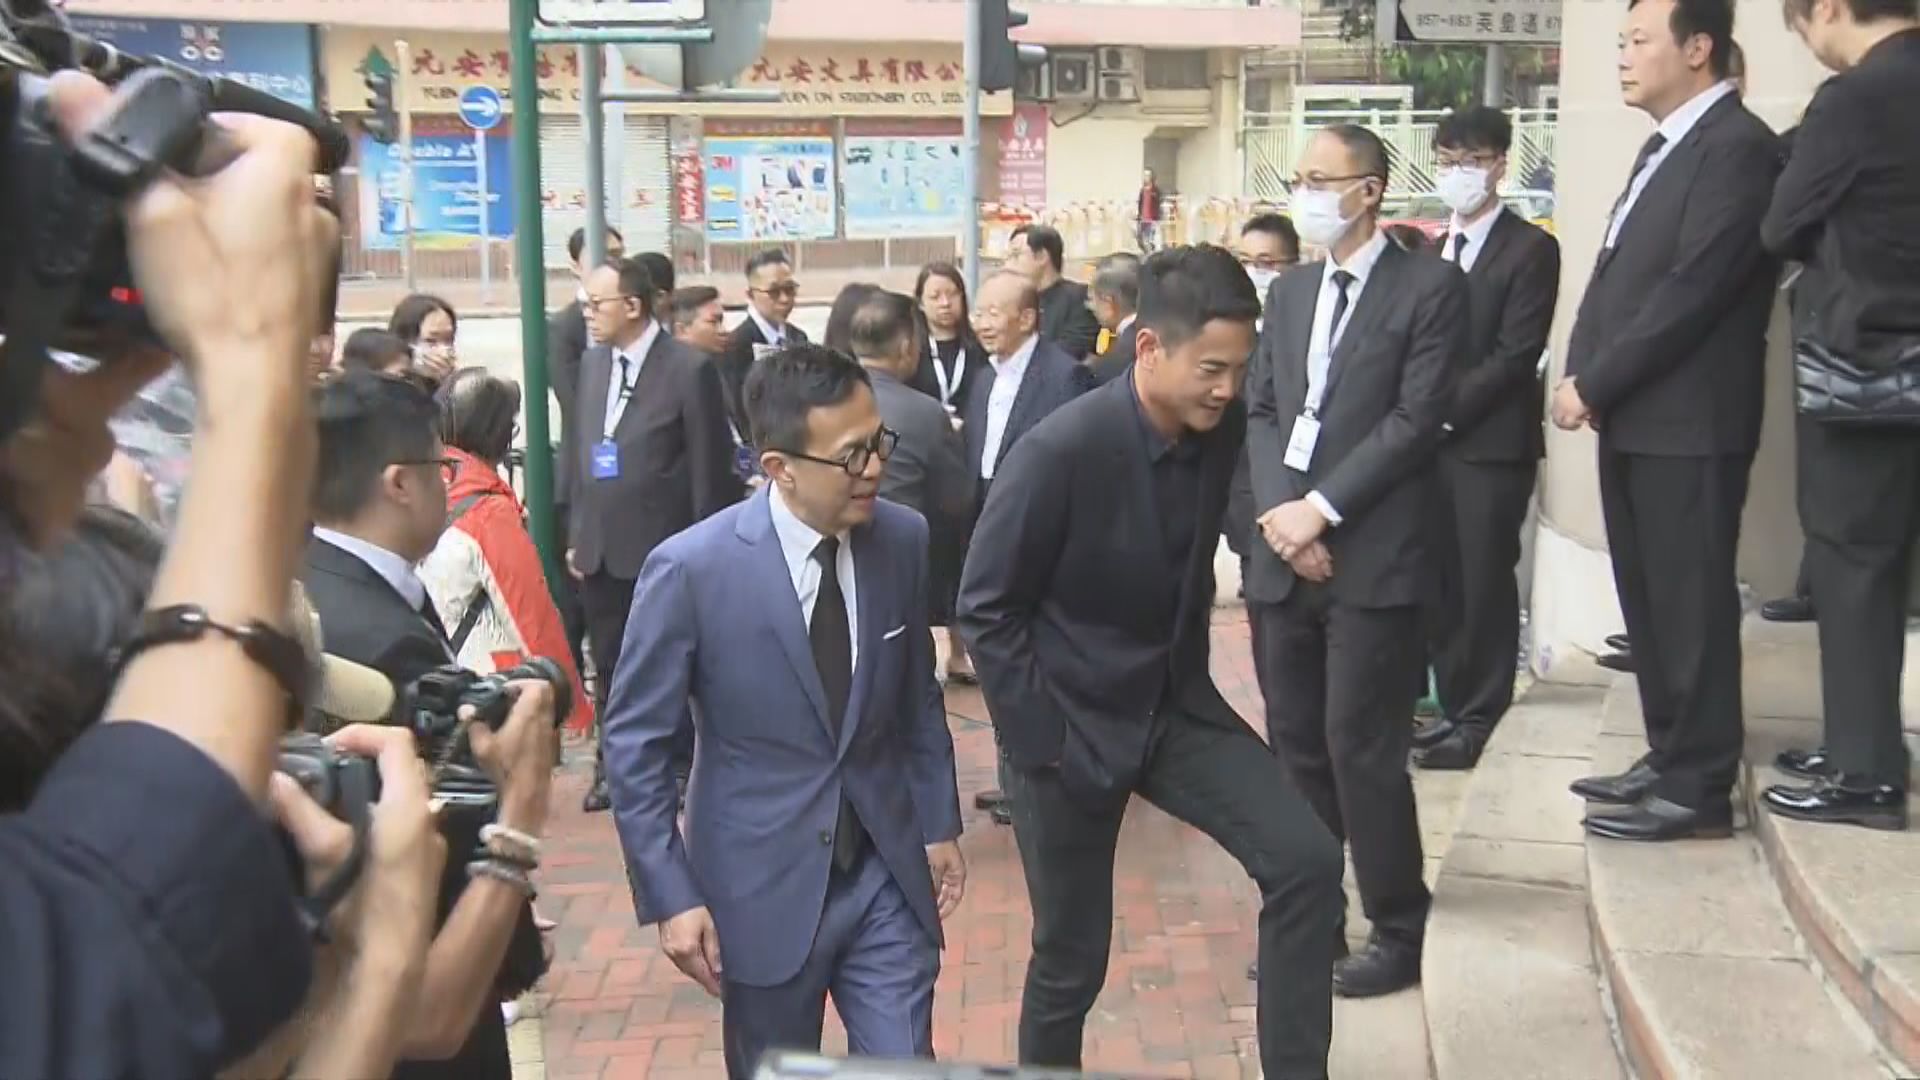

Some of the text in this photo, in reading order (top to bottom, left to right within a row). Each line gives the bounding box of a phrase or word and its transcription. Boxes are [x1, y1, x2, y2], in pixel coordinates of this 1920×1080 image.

[1476, 12, 1538, 34] 英皇道
[750, 56, 964, 84] 元安文具有限公
